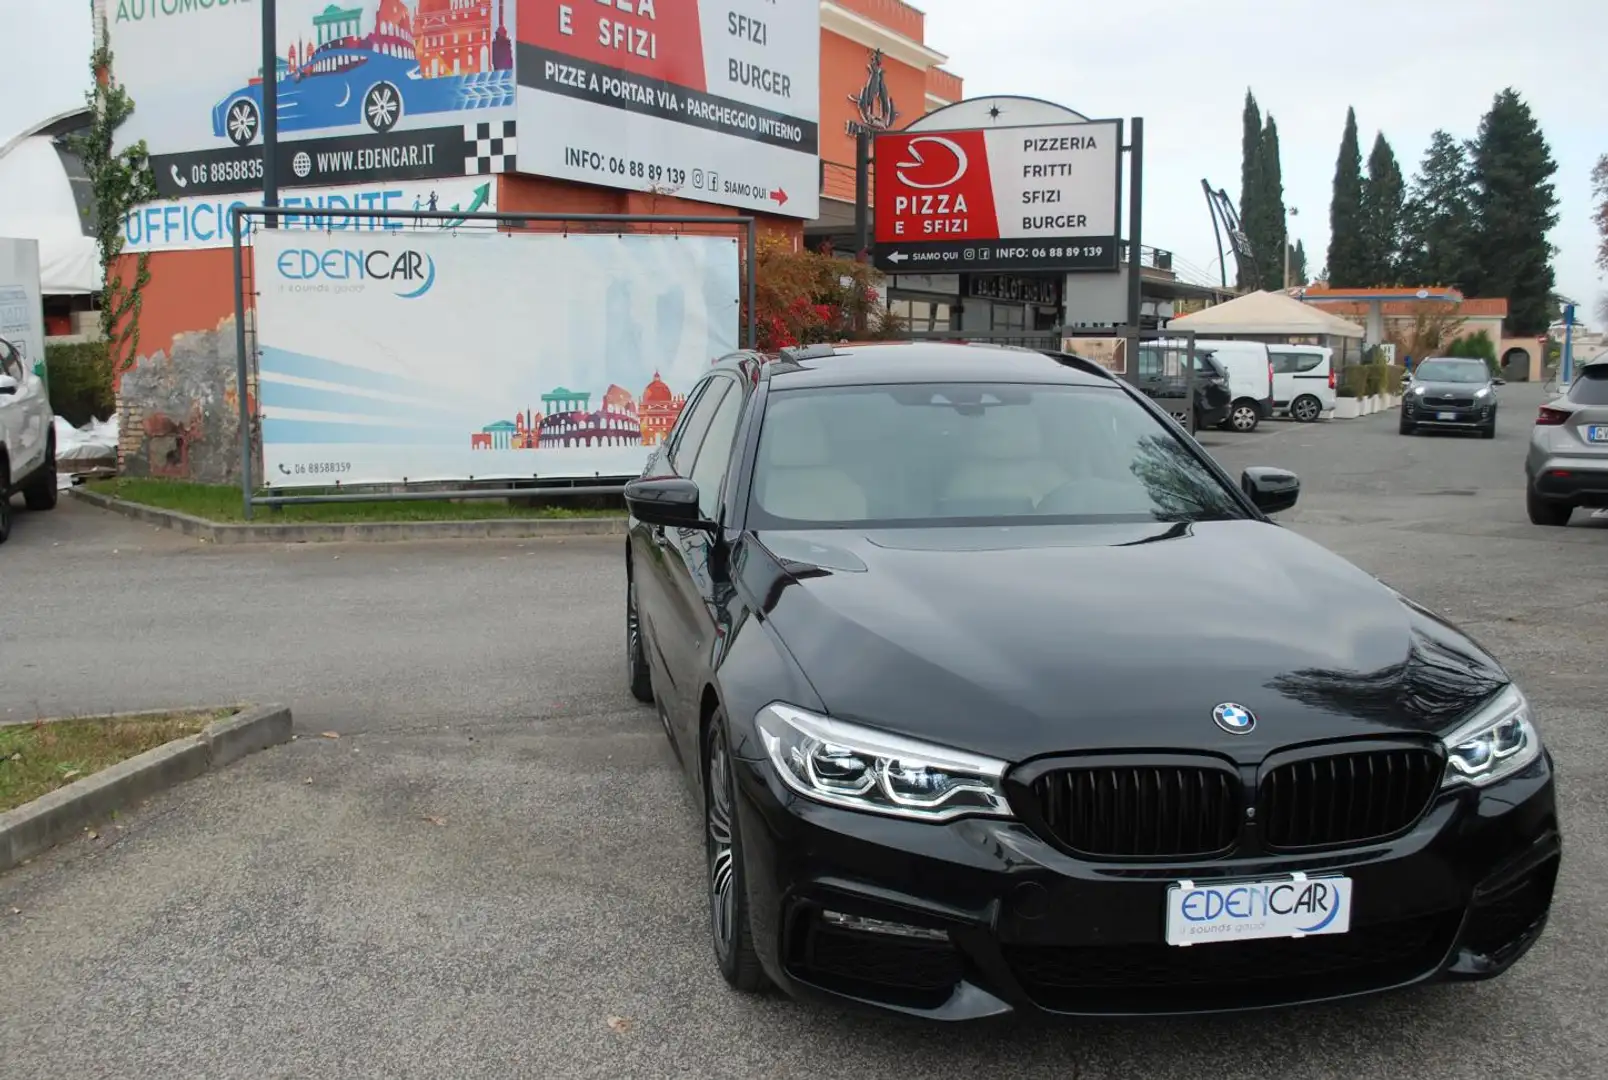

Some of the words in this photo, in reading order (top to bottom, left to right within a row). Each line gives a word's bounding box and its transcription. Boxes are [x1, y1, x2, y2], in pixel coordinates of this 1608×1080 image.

[559, 4, 574, 36] E
[598, 17, 657, 59] SFIZI
[728, 11, 768, 47] SFIZI
[728, 57, 792, 98] BURGER
[545, 60, 587, 89] PIZZE
[589, 72, 600, 93] A
[602, 75, 655, 106] PORTAR
[657, 89, 679, 112] VIA
[687, 97, 757, 130] PARCHEGGIO
[759, 117, 802, 142] INTERNO
[317, 143, 436, 173] WWW.EDENCAR.IT
[1023, 136, 1098, 152] PIZZERIA
[191, 164, 208, 184] 06
[211, 158, 264, 183] 8858835
[565, 146, 605, 173] INFO:
[609, 156, 626, 175] 06
[629, 160, 645, 178] 88
[648, 164, 663, 181] 89
[666, 167, 686, 185] 139
[724, 180, 751, 197] SIAMO
[752, 186, 767, 200] QUI
[1023, 163, 1073, 178] FRITTI
[895, 193, 968, 216] PIZZA
[1022, 189, 1061, 204] SFIZI
[125, 200, 251, 245] UFFICIO
[261, 190, 404, 231] ENDITE
[895, 220, 905, 235] E
[923, 218, 968, 234] SFIZI
[1022, 214, 1087, 230] BURGER
[277, 249, 425, 280] EDENCAR
[912, 251, 941, 261] SIAMO
[942, 251, 959, 262] QUI
[996, 248, 1029, 260] INFO:
[1032, 247, 1046, 258] 06
[1049, 247, 1062, 257] 88
[1065, 247, 1080, 258] 89
[1082, 246, 1103, 257] 139
[295, 463, 306, 474] 06
[1181, 882, 1328, 922] EDENCAR
